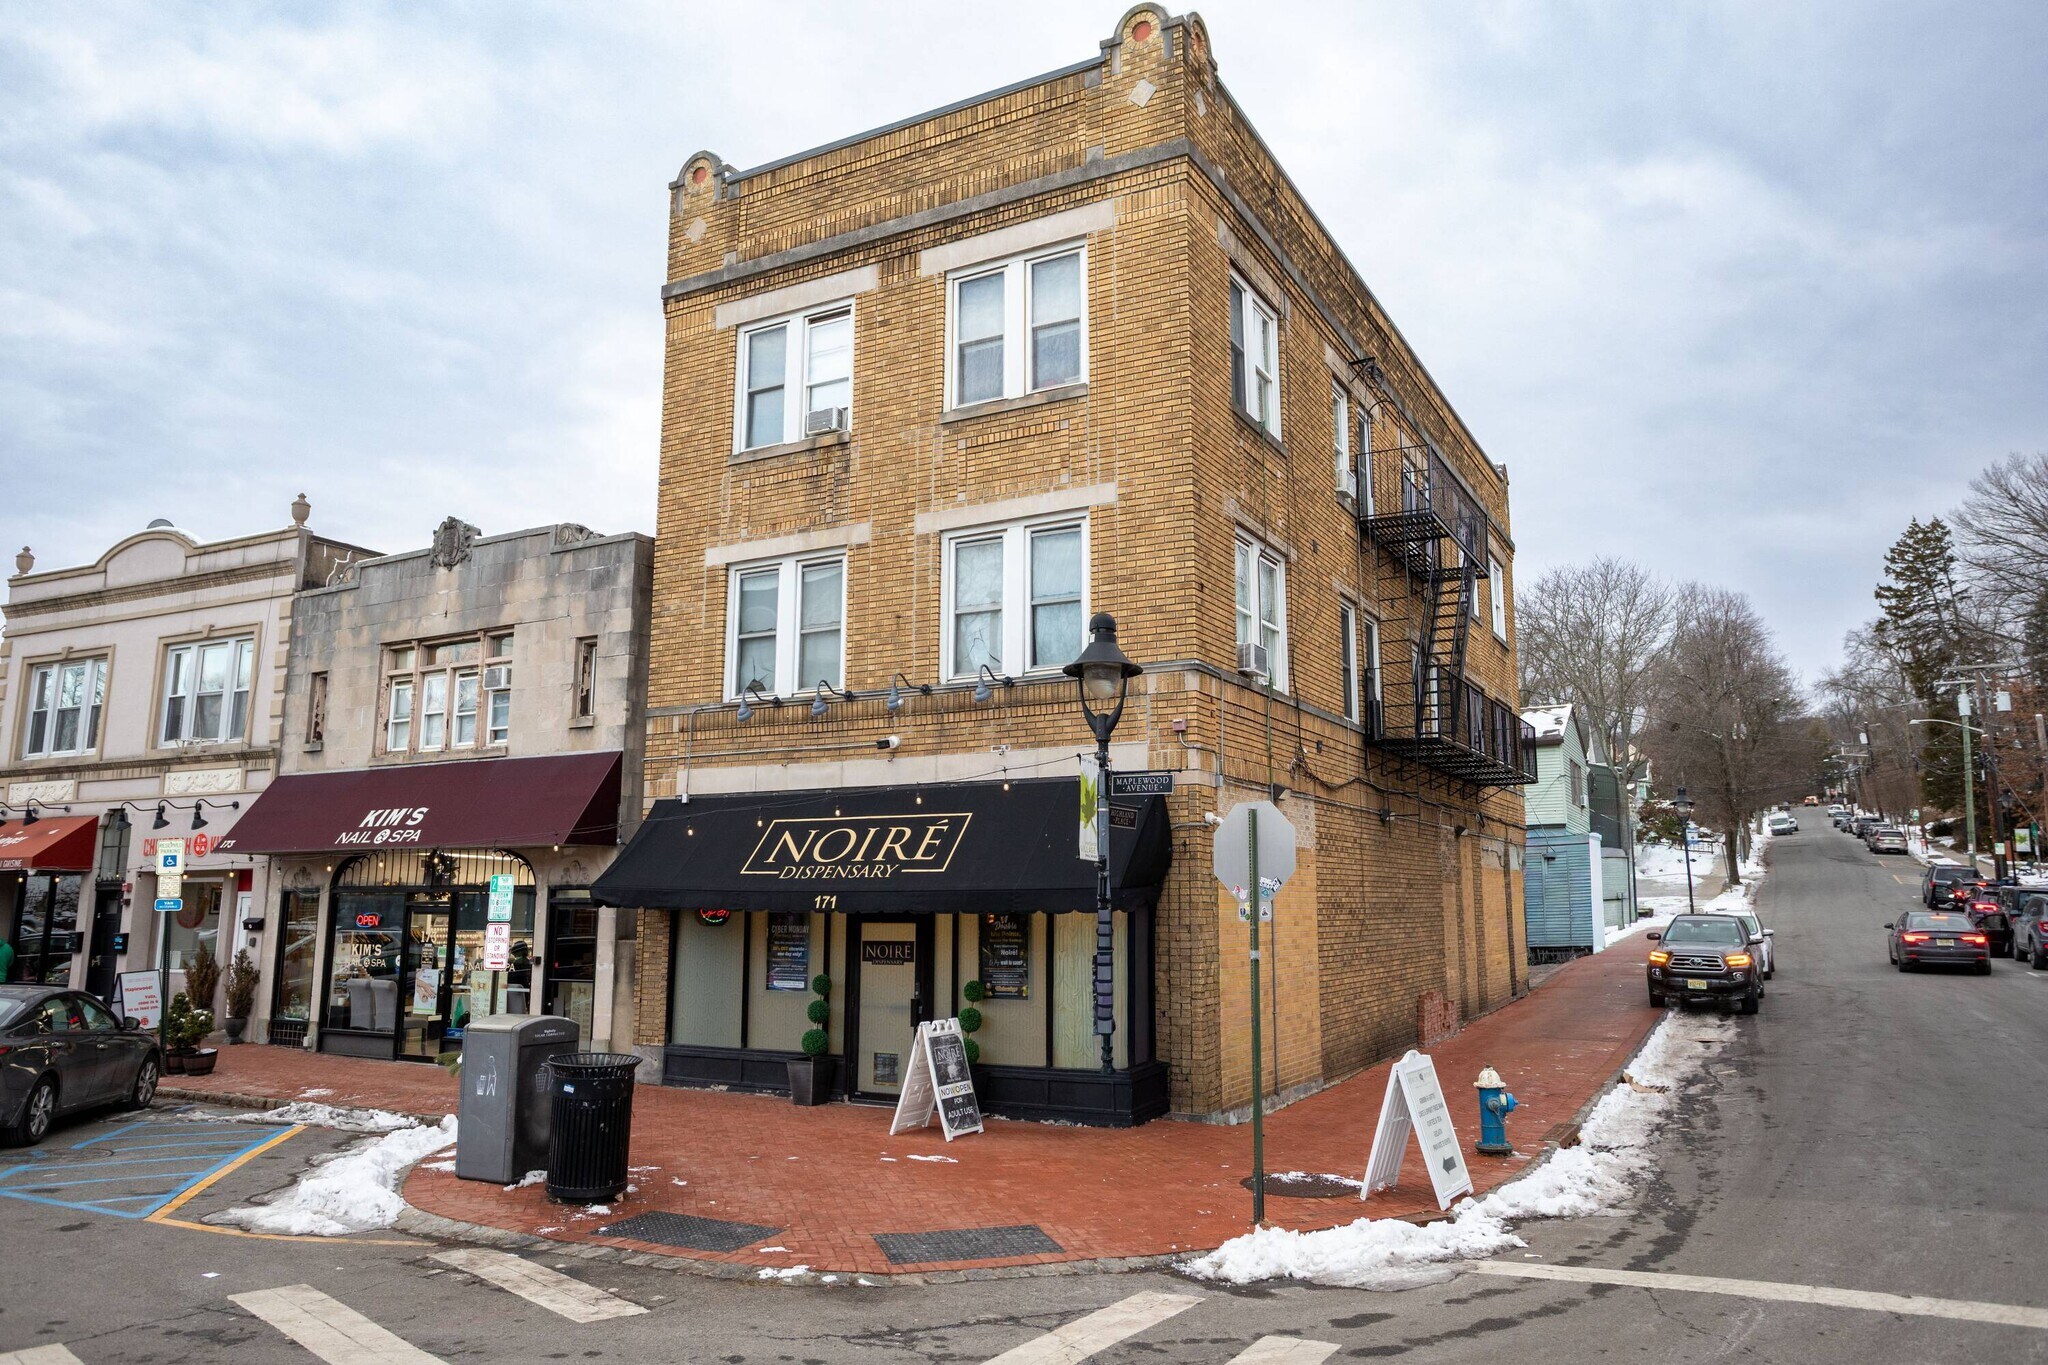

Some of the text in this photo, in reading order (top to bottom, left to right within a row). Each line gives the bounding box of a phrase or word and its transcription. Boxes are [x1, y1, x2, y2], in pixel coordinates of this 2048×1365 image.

[1116, 776, 1169, 785] MAPLEWOOD
[1125, 784, 1159, 792] AVENUE
[358, 807, 430, 828] KIM'S
[1111, 809, 1135, 819] HIGHLAND
[1115, 817, 1129, 826] PLACE
[334, 831, 372, 844] NAIL
[389, 829, 422, 843] SPA
[764, 819, 949, 863] NOIRÉ
[220, 840, 237, 849] 173
[778, 864, 900, 879] DISPENSARY
[491, 878, 497, 890] 2
[814, 895, 837, 910] 171
[357, 914, 379, 926] OPEN
[493, 926, 503, 936] NO
[771, 925, 810, 934] CYBER MONDAY
[421, 931, 437, 943] 173
[351, 943, 382, 956] KIM'S
[866, 943, 911, 958] NOIRÉ
[371, 958, 387, 968] SPA
[468, 962, 484, 971] NAI
[940, 1083, 971, 1097] NOW OPEN
[948, 1106, 974, 1120] ADULT USE
